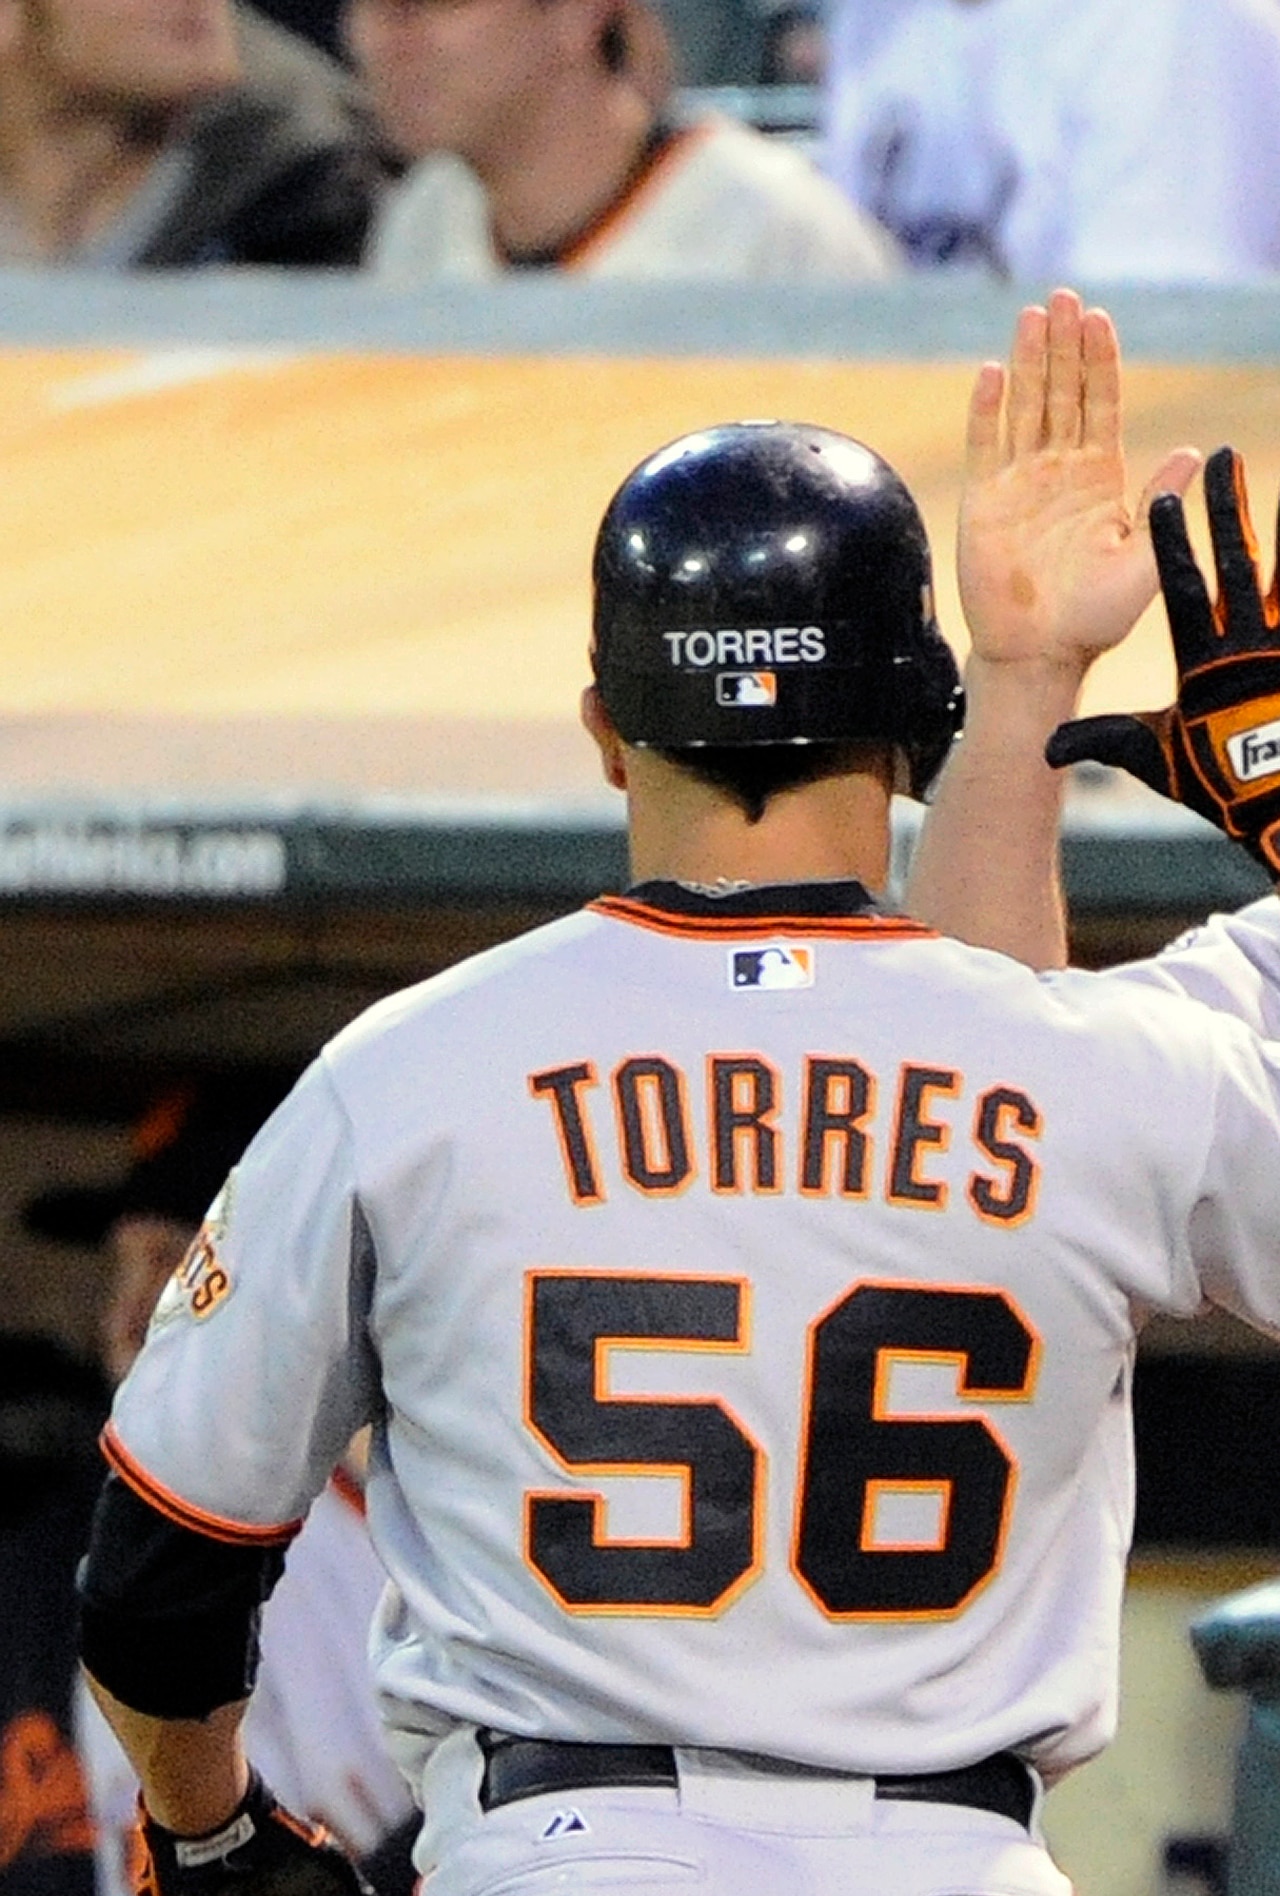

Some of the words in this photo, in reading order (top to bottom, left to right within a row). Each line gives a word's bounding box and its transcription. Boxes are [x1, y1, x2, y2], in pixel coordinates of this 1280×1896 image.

[662, 626, 826, 666] TORRES
[527, 1049, 1043, 1231] TORRES
[523, 1268, 1044, 1625] 56
